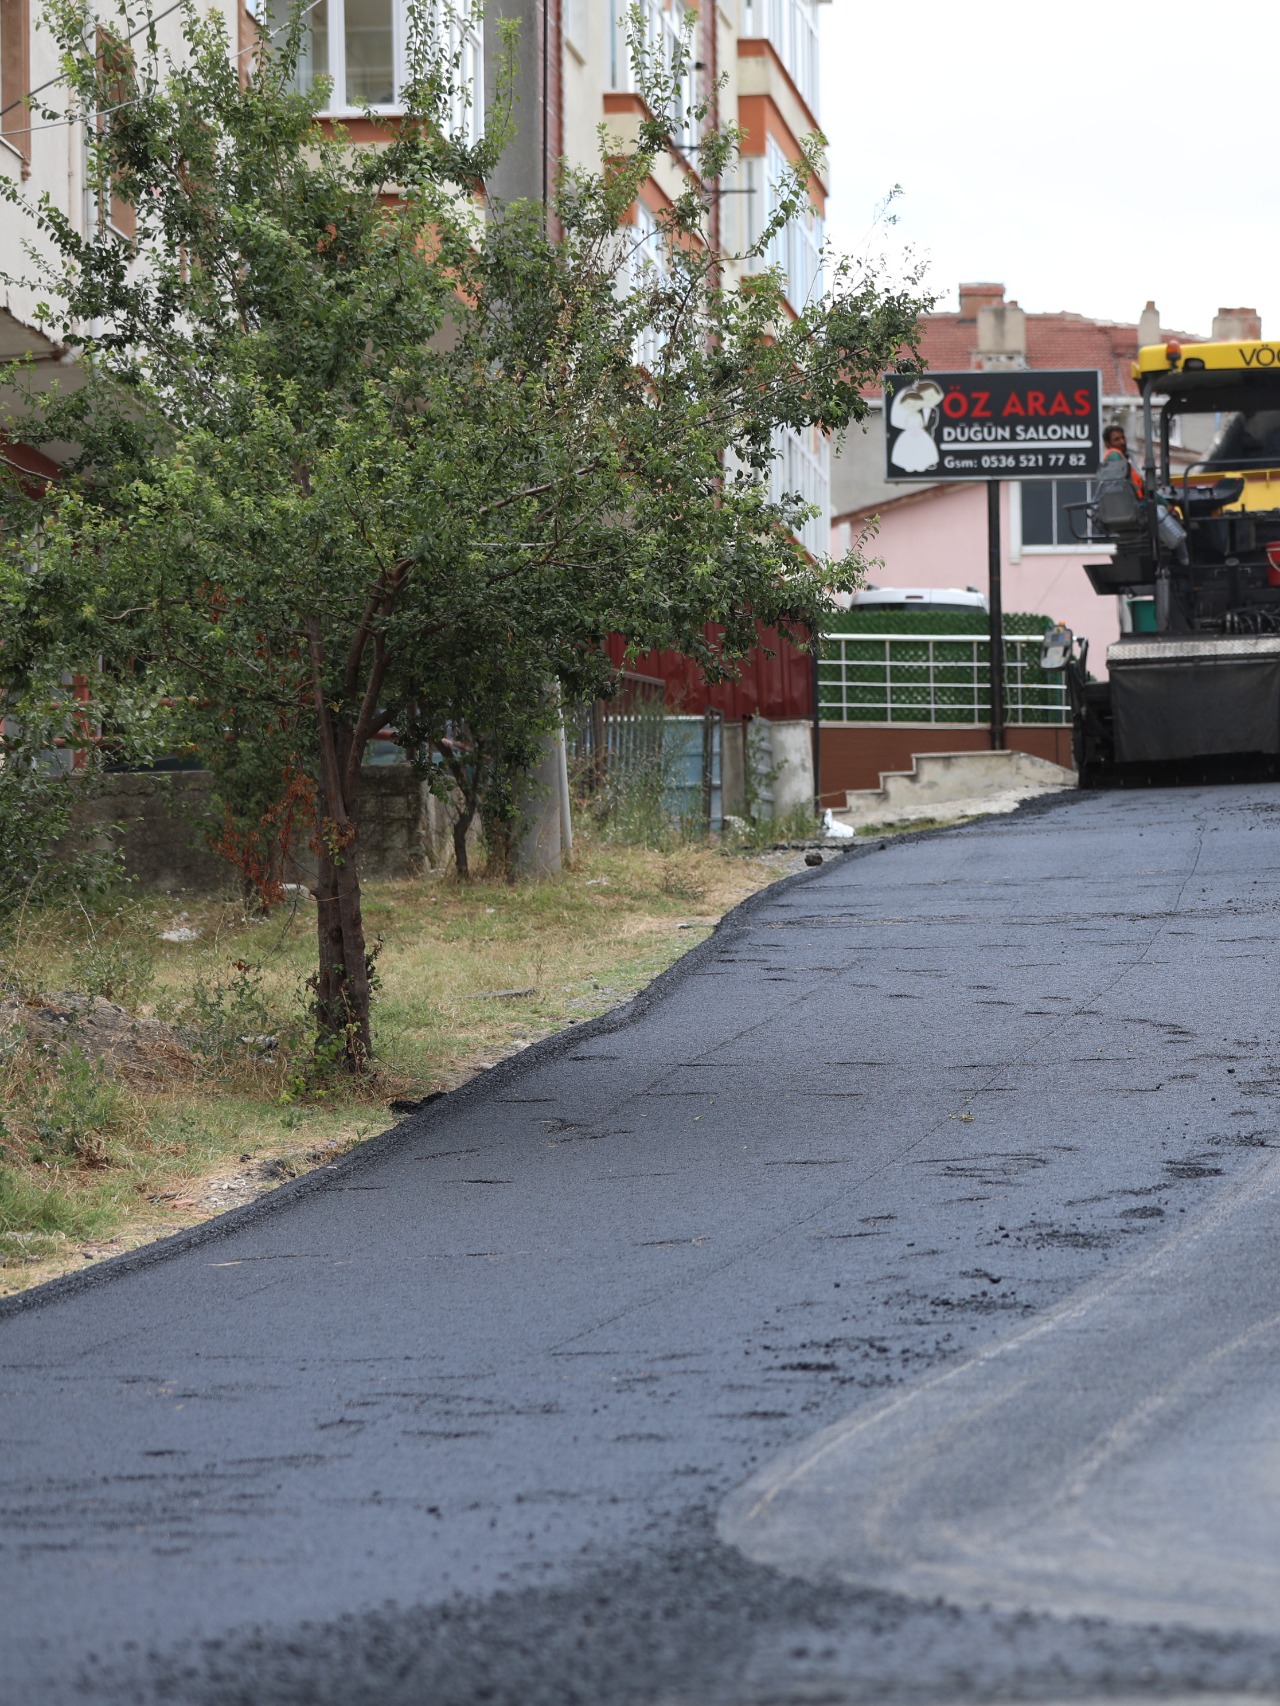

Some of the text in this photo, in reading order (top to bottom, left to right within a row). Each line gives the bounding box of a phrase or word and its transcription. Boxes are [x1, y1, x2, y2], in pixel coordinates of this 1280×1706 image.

[942, 385, 1092, 419] ÖZ ARAS
[943, 422, 1089, 442] DÜĞÜN SALONU
[944, 454, 1086, 469] Gsm: 0536 521 77 82
